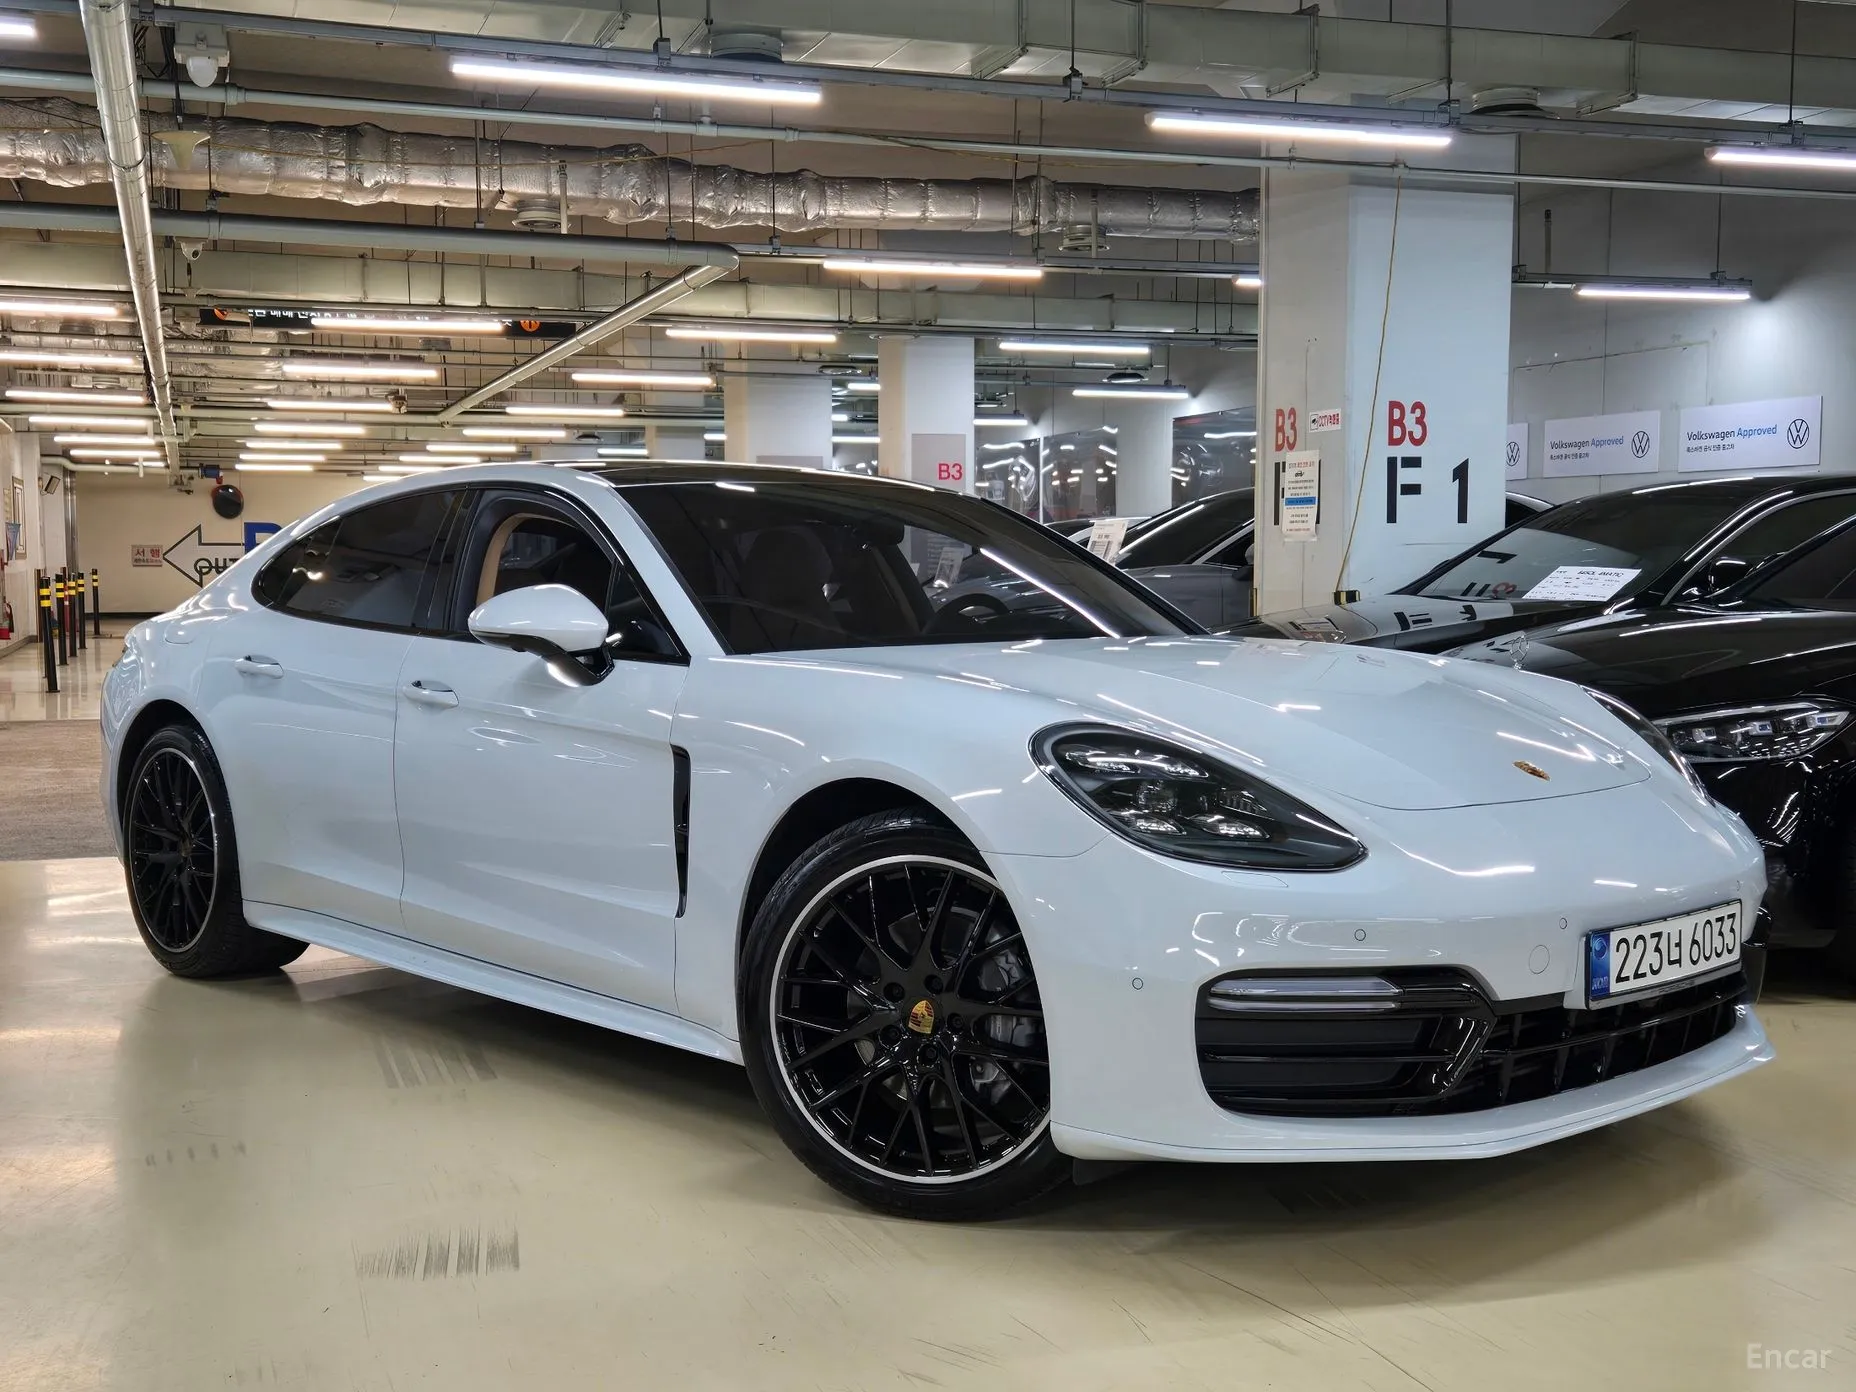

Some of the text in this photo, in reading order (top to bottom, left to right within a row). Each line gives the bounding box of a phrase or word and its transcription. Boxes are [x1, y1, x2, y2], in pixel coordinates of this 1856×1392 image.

[1274, 407, 1298, 452] B3
[1387, 400, 1428, 447] B3
[1550, 435, 1624, 450] Volkswagen Approved
[1686, 424, 1778, 441] Volkswagen Approved
[938, 462, 963, 481] B3
[1386, 456, 1422, 524] F
[1452, 457, 1470, 524] 1
[1615, 912, 1737, 984] 223너 6033
